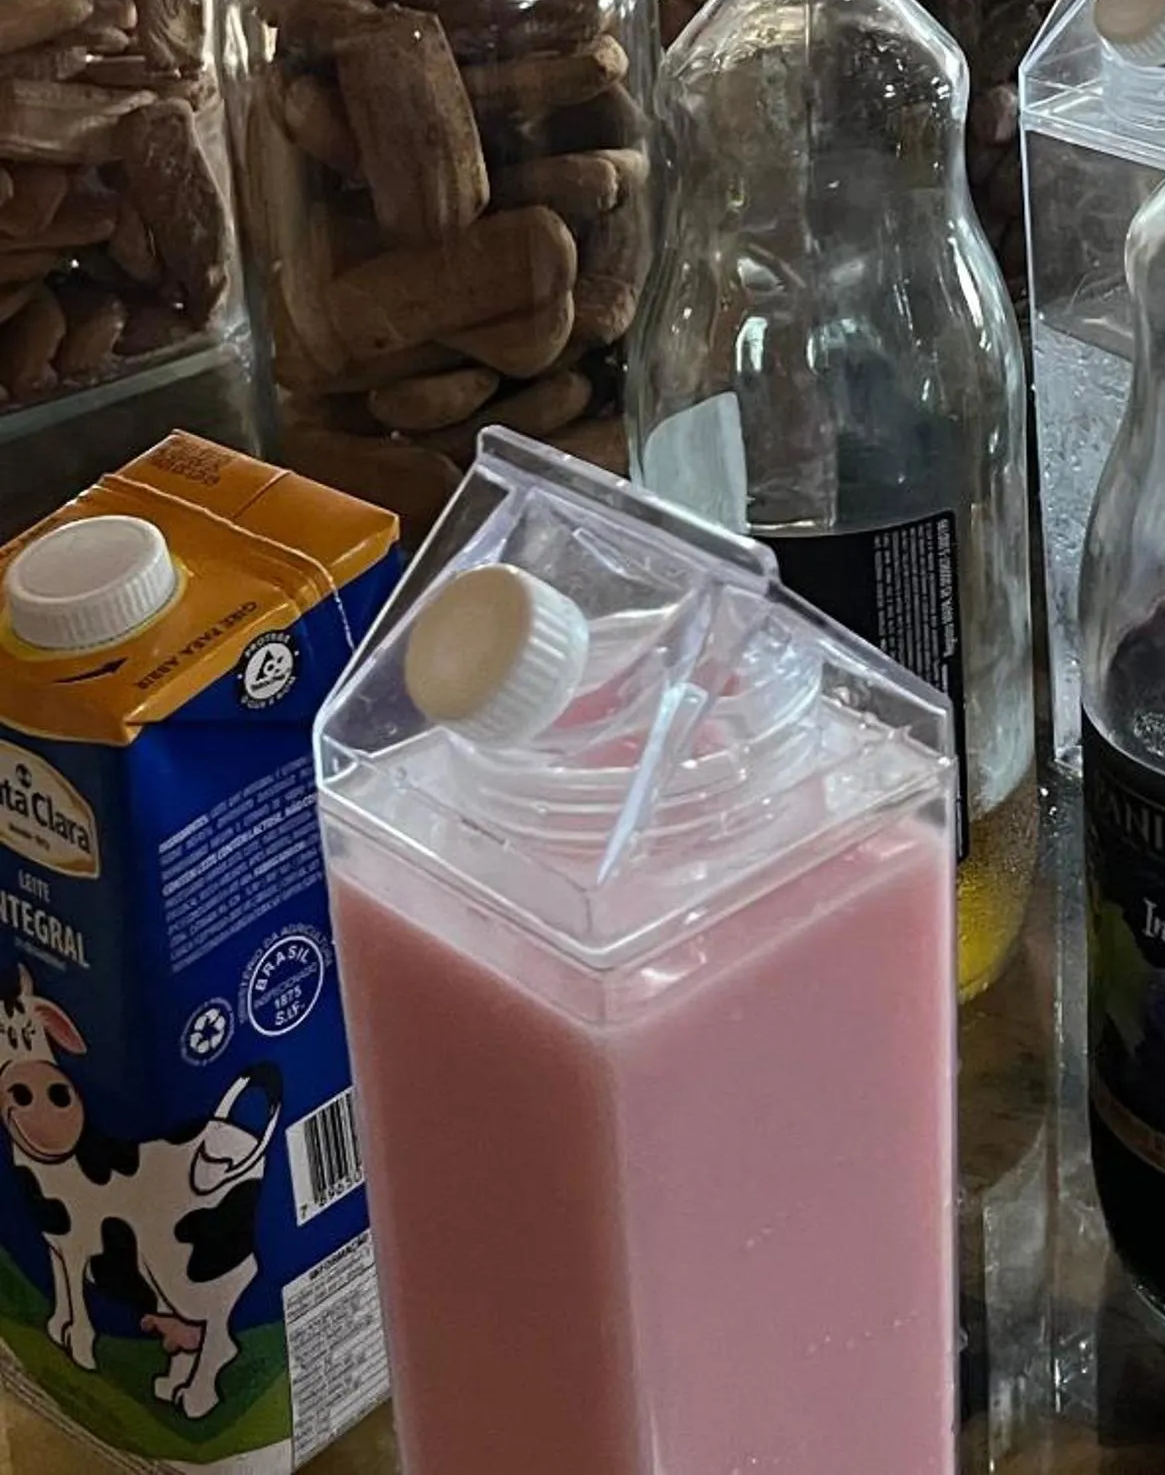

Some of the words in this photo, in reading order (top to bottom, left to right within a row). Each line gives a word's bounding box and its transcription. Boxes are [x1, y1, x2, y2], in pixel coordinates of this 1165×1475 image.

[32, 792, 91, 855] Clara
[18, 869, 50, 904] LEITE
[0, 890, 90, 969] NTEGRAL
[255, 945, 310, 992] BRASIL
[274, 985, 302, 1009] 1875
